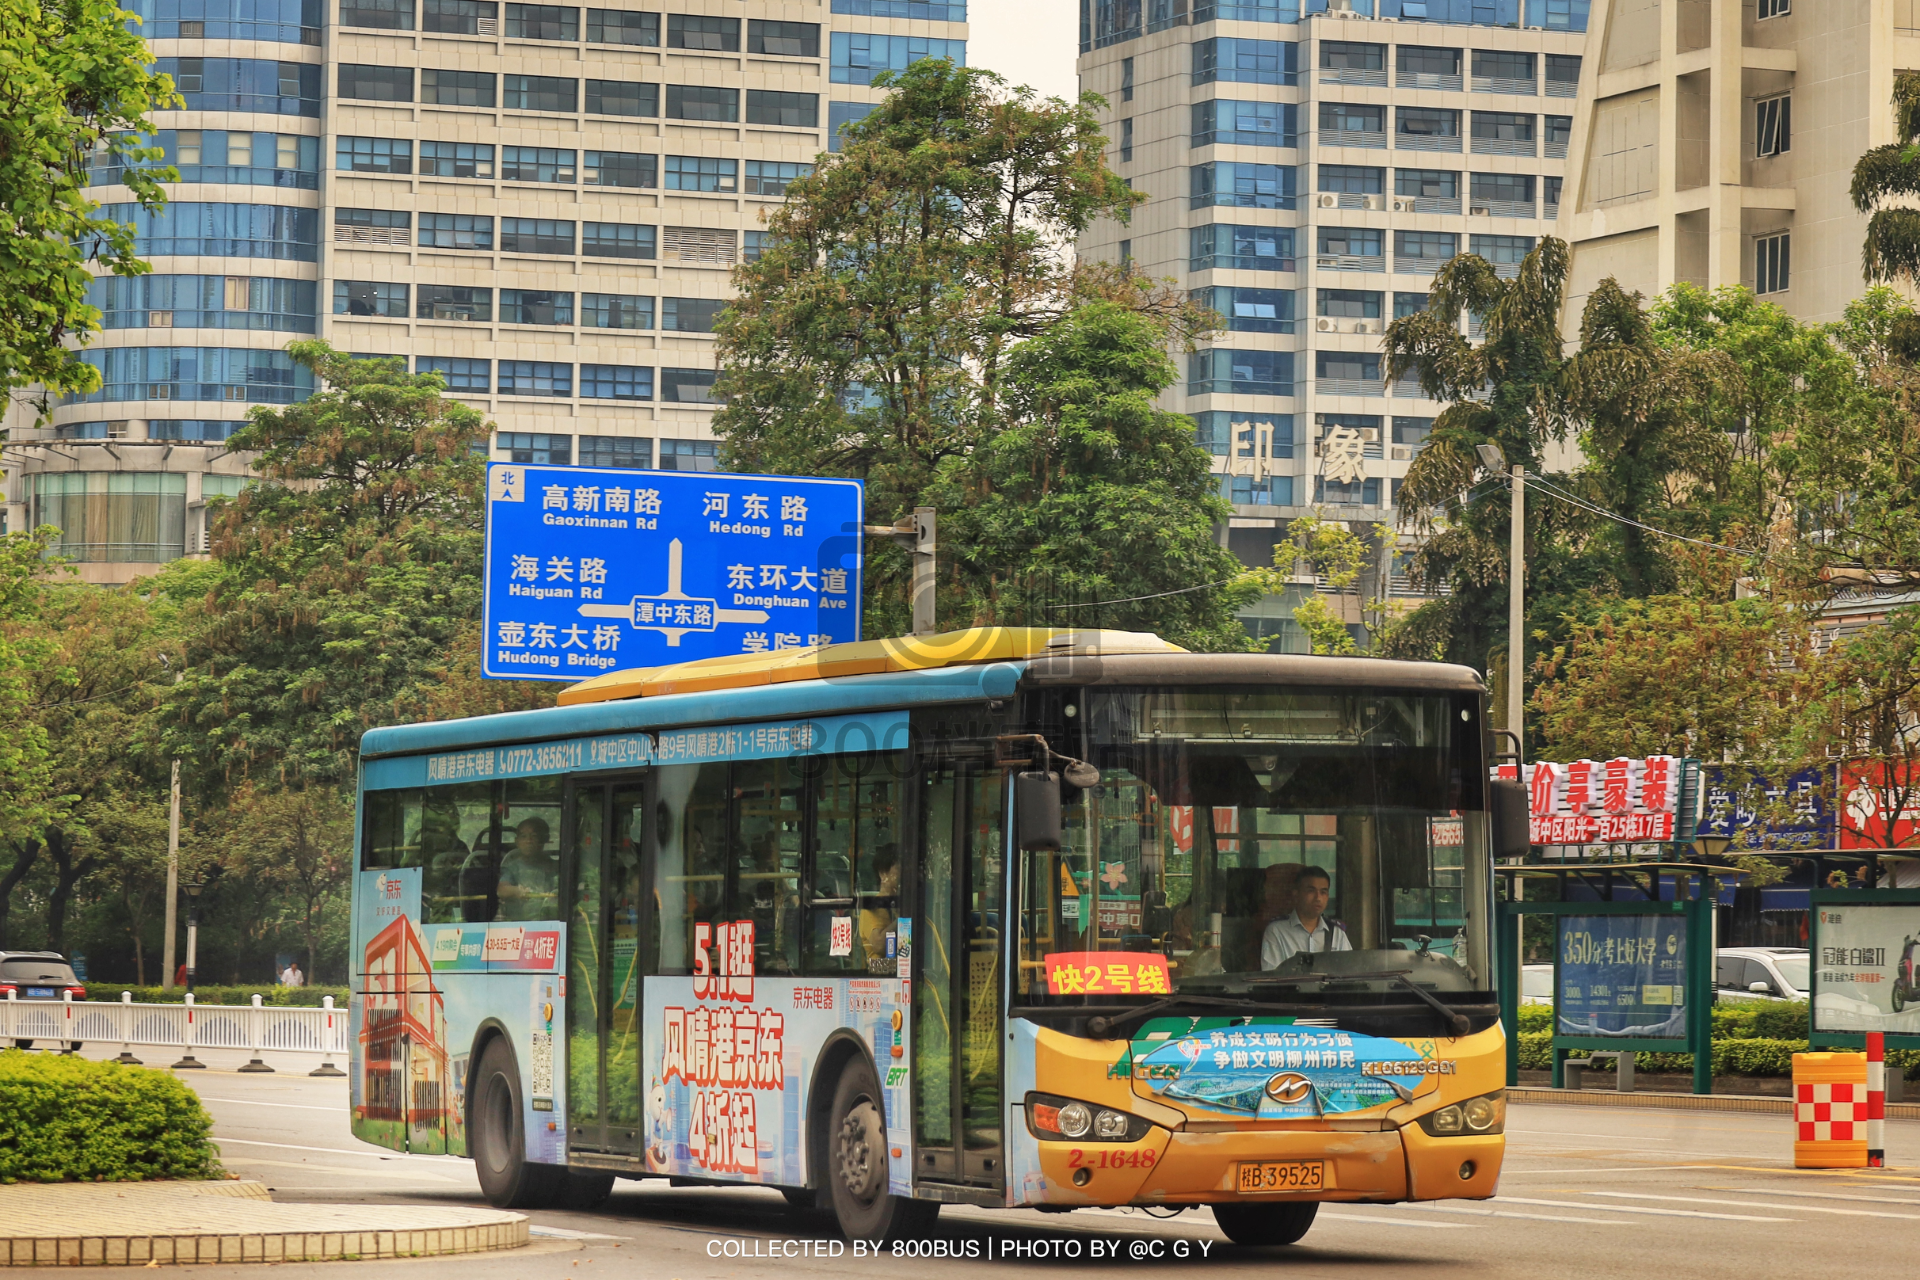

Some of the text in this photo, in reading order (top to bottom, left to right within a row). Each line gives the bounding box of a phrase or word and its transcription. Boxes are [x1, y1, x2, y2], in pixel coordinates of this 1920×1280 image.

[1229, 420, 1368, 484] 印象
[501, 471, 514, 486] 北
[542, 484, 662, 515] 高新南路
[702, 491, 808, 521] 河东路
[543, 513, 657, 530] Gaoxinnan Rd
[709, 521, 803, 538] Hedong Rd
[510, 555, 608, 584] 海关路
[727, 563, 848, 595] 东环大道
[509, 584, 603, 600] Haiguan Rd
[733, 593, 847, 610] Donghuan Ave
[636, 602, 712, 626] 潭中东路
[498, 621, 621, 653] 壶东大桥
[498, 651, 616, 669] Hudong Bridge
[507, 743, 582, 773] 0772-3656211
[1498, 755, 1674, 816] 价享豪装
[1529, 814, 1667, 843] 城中区阳光一百25栋17层
[386, 879, 401, 899] 京东
[534, 936, 555, 959] 4折起
[832, 922, 851, 950] 快2号线
[693, 920, 755, 1003] 5.1逛
[1052, 964, 1167, 994] 快2号线
[793, 986, 833, 1010] 京东电器
[662, 1005, 783, 1090] 风晴港京东
[1210, 1032, 1353, 1048] 养成文明行为习惯
[1107, 1063, 1181, 1080] HIGER
[1213, 1050, 1355, 1069] 争做文明柳州市民
[1361, 1060, 1457, 1077] KLQ6129GQ1
[886, 1067, 908, 1087] BRT
[689, 1090, 758, 1174] 4折起
[1068, 1148, 1156, 1169] 2-1648
